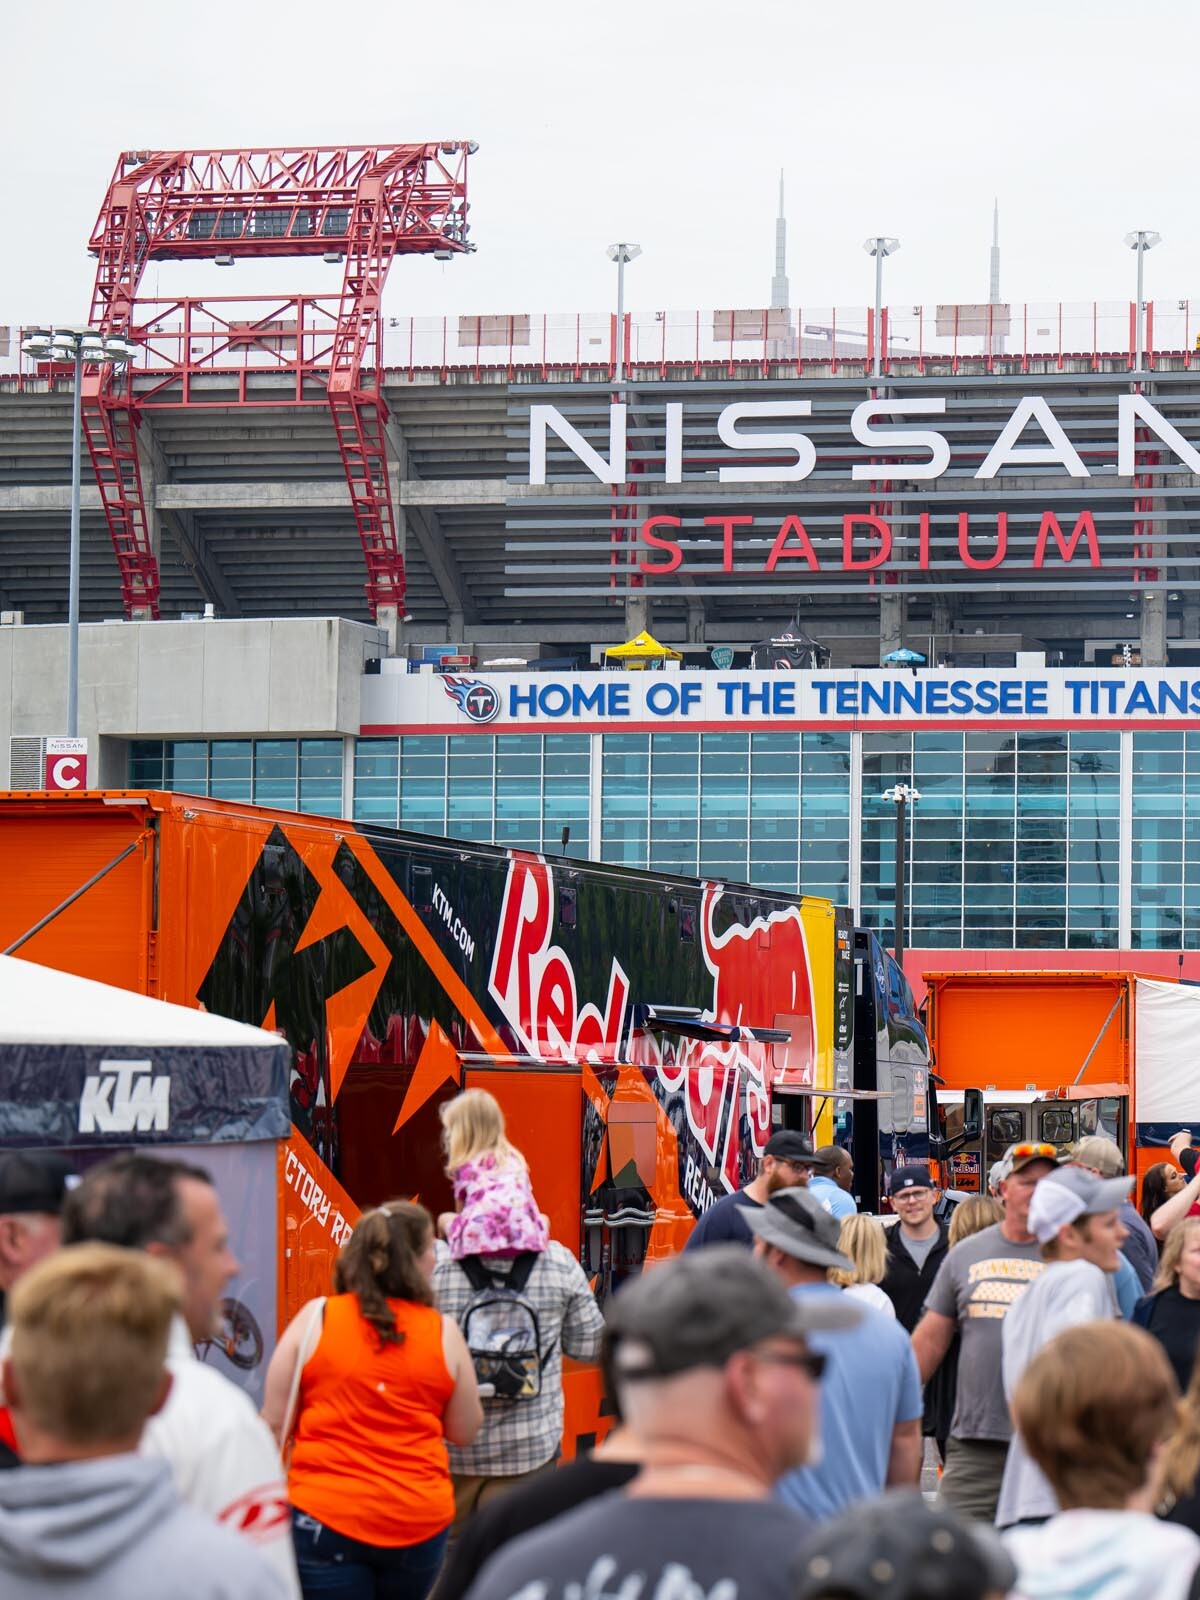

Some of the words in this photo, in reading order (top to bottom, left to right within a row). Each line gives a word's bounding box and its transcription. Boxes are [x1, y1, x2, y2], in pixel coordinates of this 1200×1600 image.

[639, 510, 1103, 575] STADIUM
[508, 682, 630, 717] HOME
[646, 681, 702, 716] OF
[717, 681, 796, 715] THE
[811, 680, 1049, 715] TENNESSEE
[52, 757, 81, 790] C
[431, 882, 476, 963] KTM.COM
[77, 1059, 171, 1134] KTM
[284, 1145, 332, 1228] CTORY
[683, 1154, 717, 1213] READ
